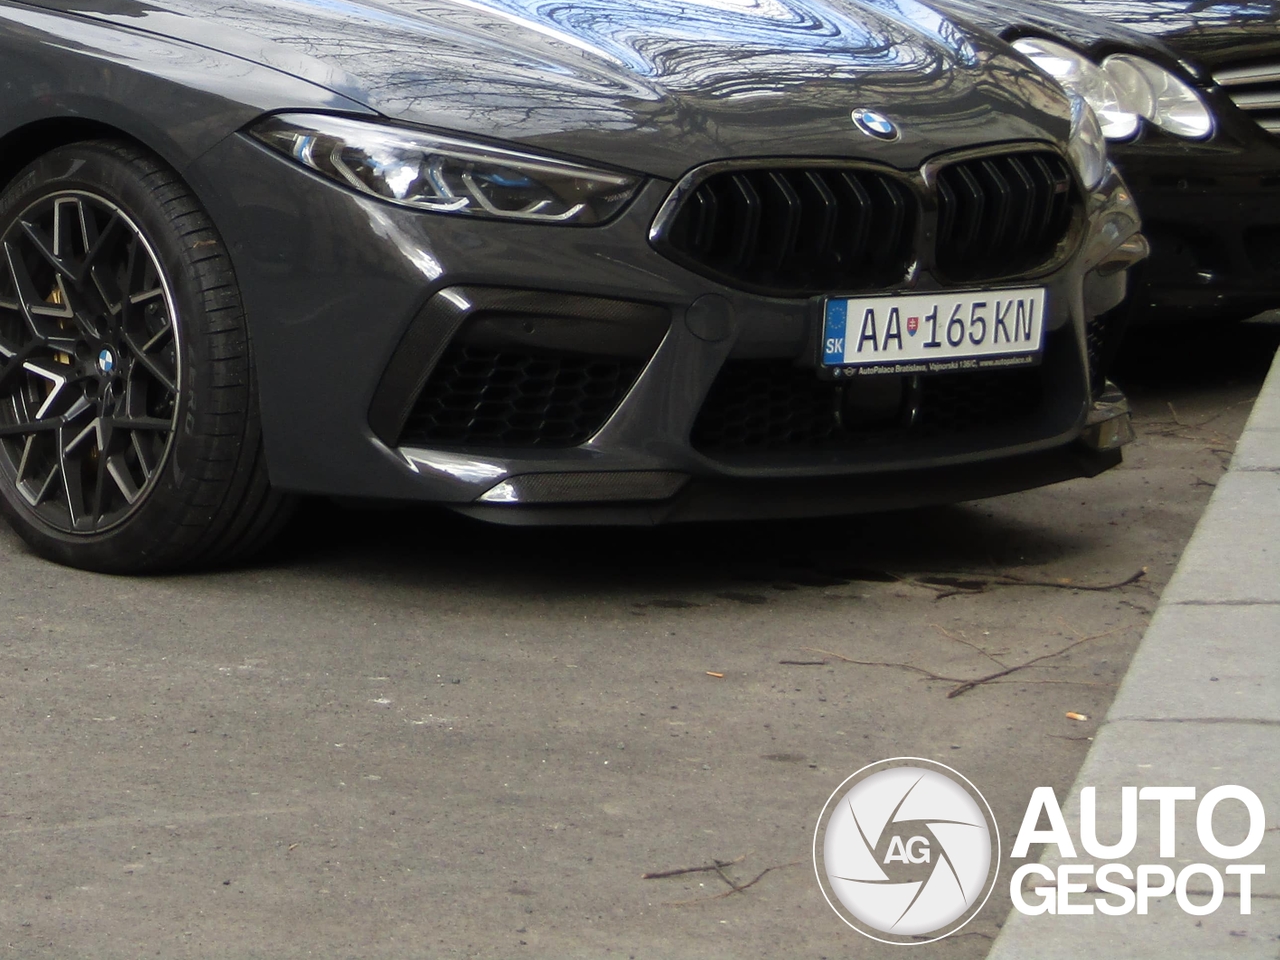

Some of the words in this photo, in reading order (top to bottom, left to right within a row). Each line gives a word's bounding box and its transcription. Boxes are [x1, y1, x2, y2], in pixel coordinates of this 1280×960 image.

[856, 307, 903, 353] AA
[922, 298, 1036, 349] 165KN
[825, 338, 843, 354] SK
[858, 365, 894, 375] AutoPalace
